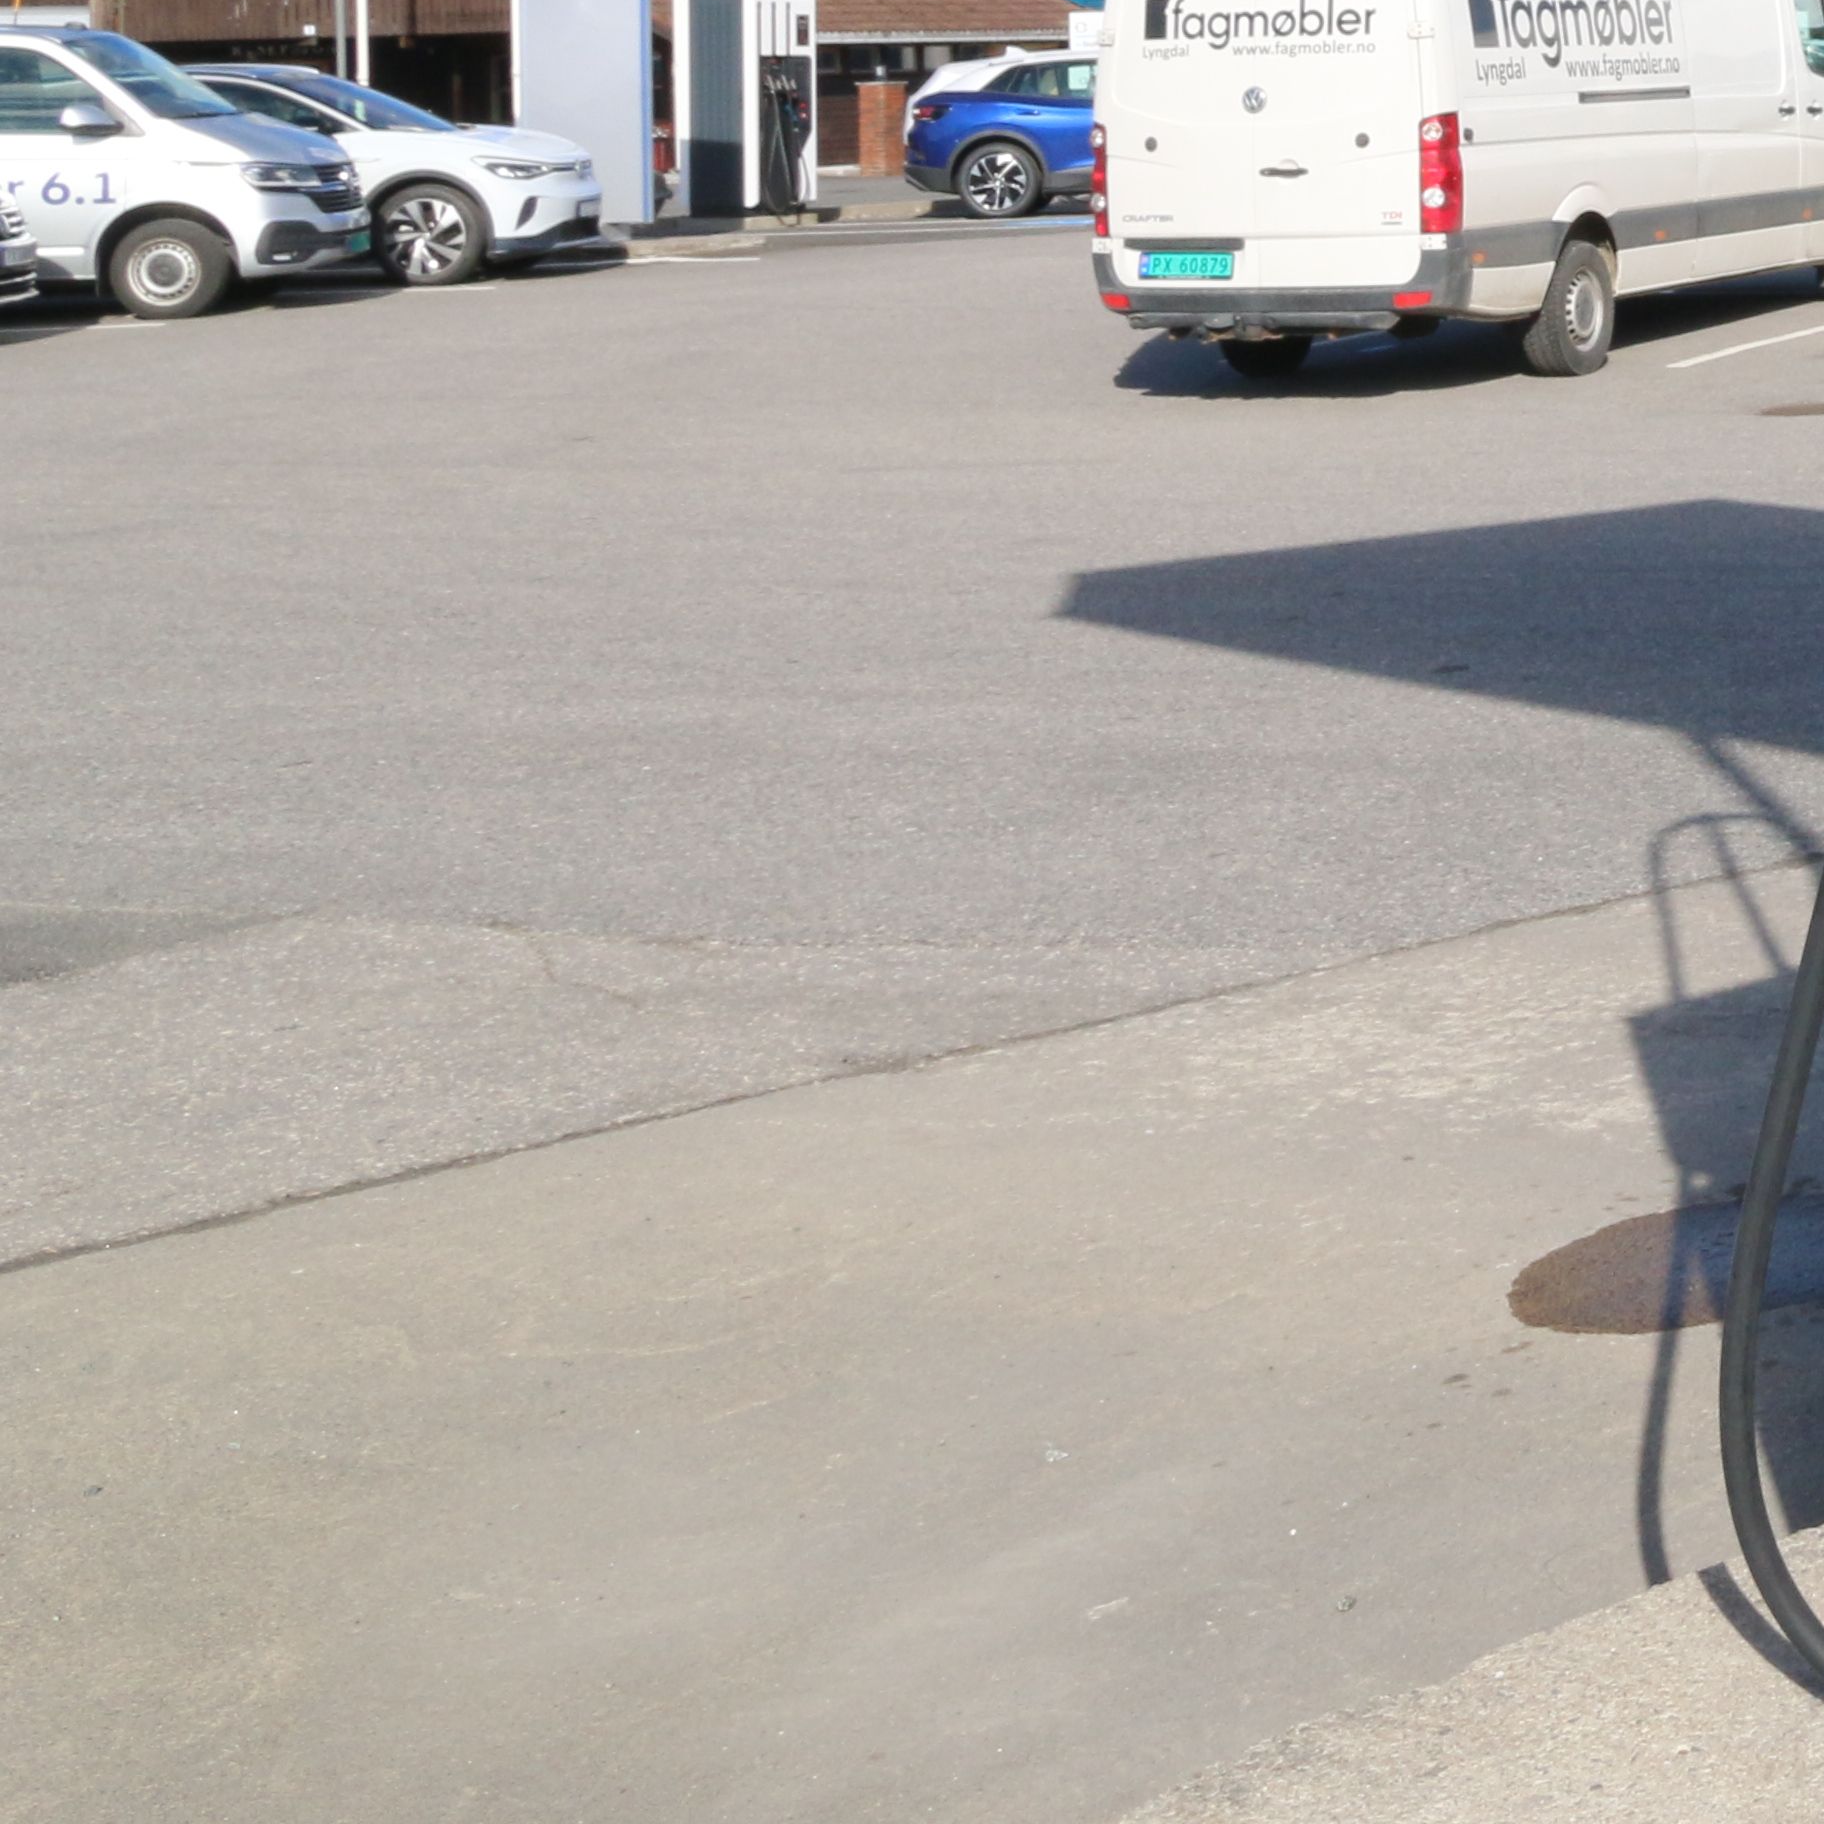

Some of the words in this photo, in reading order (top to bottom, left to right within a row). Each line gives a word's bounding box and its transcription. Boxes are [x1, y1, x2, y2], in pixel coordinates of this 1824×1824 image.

[1142, 44, 1190, 61] Lyngdal
[1475, 57, 1527, 86] Lyngdal
[41, 172, 117, 205] 6.1
[1152, 257, 1173, 274] PX
[1180, 257, 1229, 275] 60879
